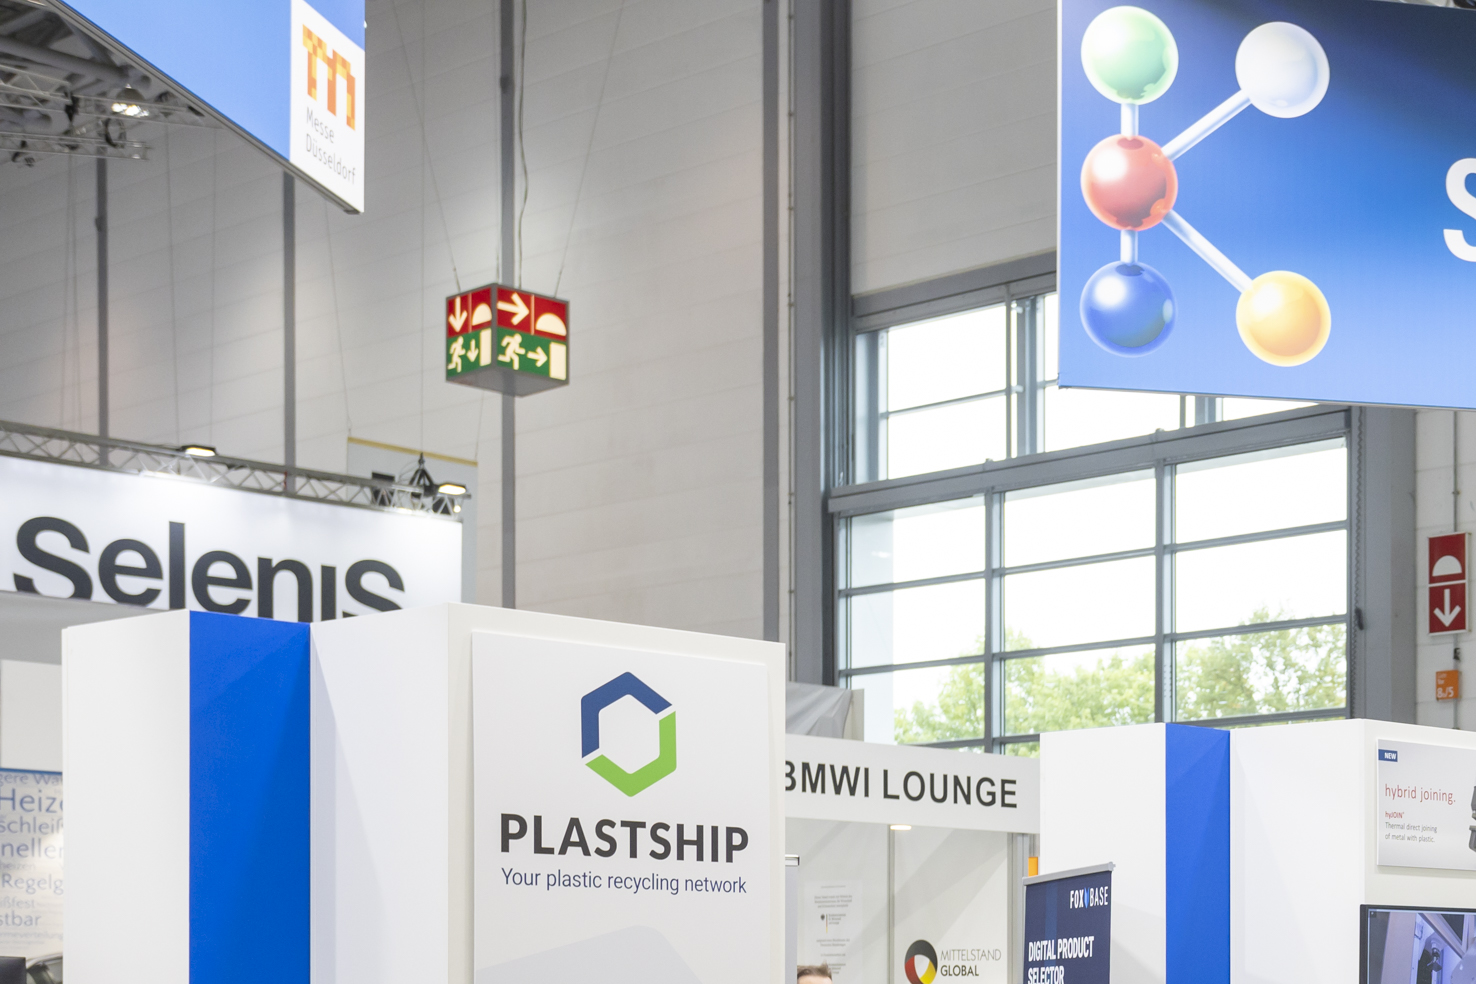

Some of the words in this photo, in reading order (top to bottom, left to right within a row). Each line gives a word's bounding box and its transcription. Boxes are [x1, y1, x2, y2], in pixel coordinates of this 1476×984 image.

[306, 106, 335, 145] Messe
[306, 132, 357, 186] Düsseldorf
[12, 515, 406, 624] Selenis
[1384, 752, 1397, 760] NEW
[882, 769, 1018, 809] LOUNGE
[1385, 784, 1417, 801] hybrid
[1420, 787, 1456, 806] joining.
[500, 813, 749, 864] PLASTSHIP
[1384, 832, 1391, 841] of
[1391, 833, 1406, 841] metal
[1406, 834, 1418, 842] with
[1418, 834, 1436, 843] plastic.
[1385, 821, 1406, 830] Thermal
[1421, 824, 1438, 834] joining
[501, 867, 541, 886] Your
[546, 869, 602, 891] plastic
[607, 873, 680, 895] recycling
[684, 876, 747, 893] network
[940, 948, 1002, 962] MITTELSTAND
[1028, 940, 1056, 962] DIGITAL
[1057, 935, 1095, 959] PRODUCT
[940, 964, 980, 977] GLOBAL
